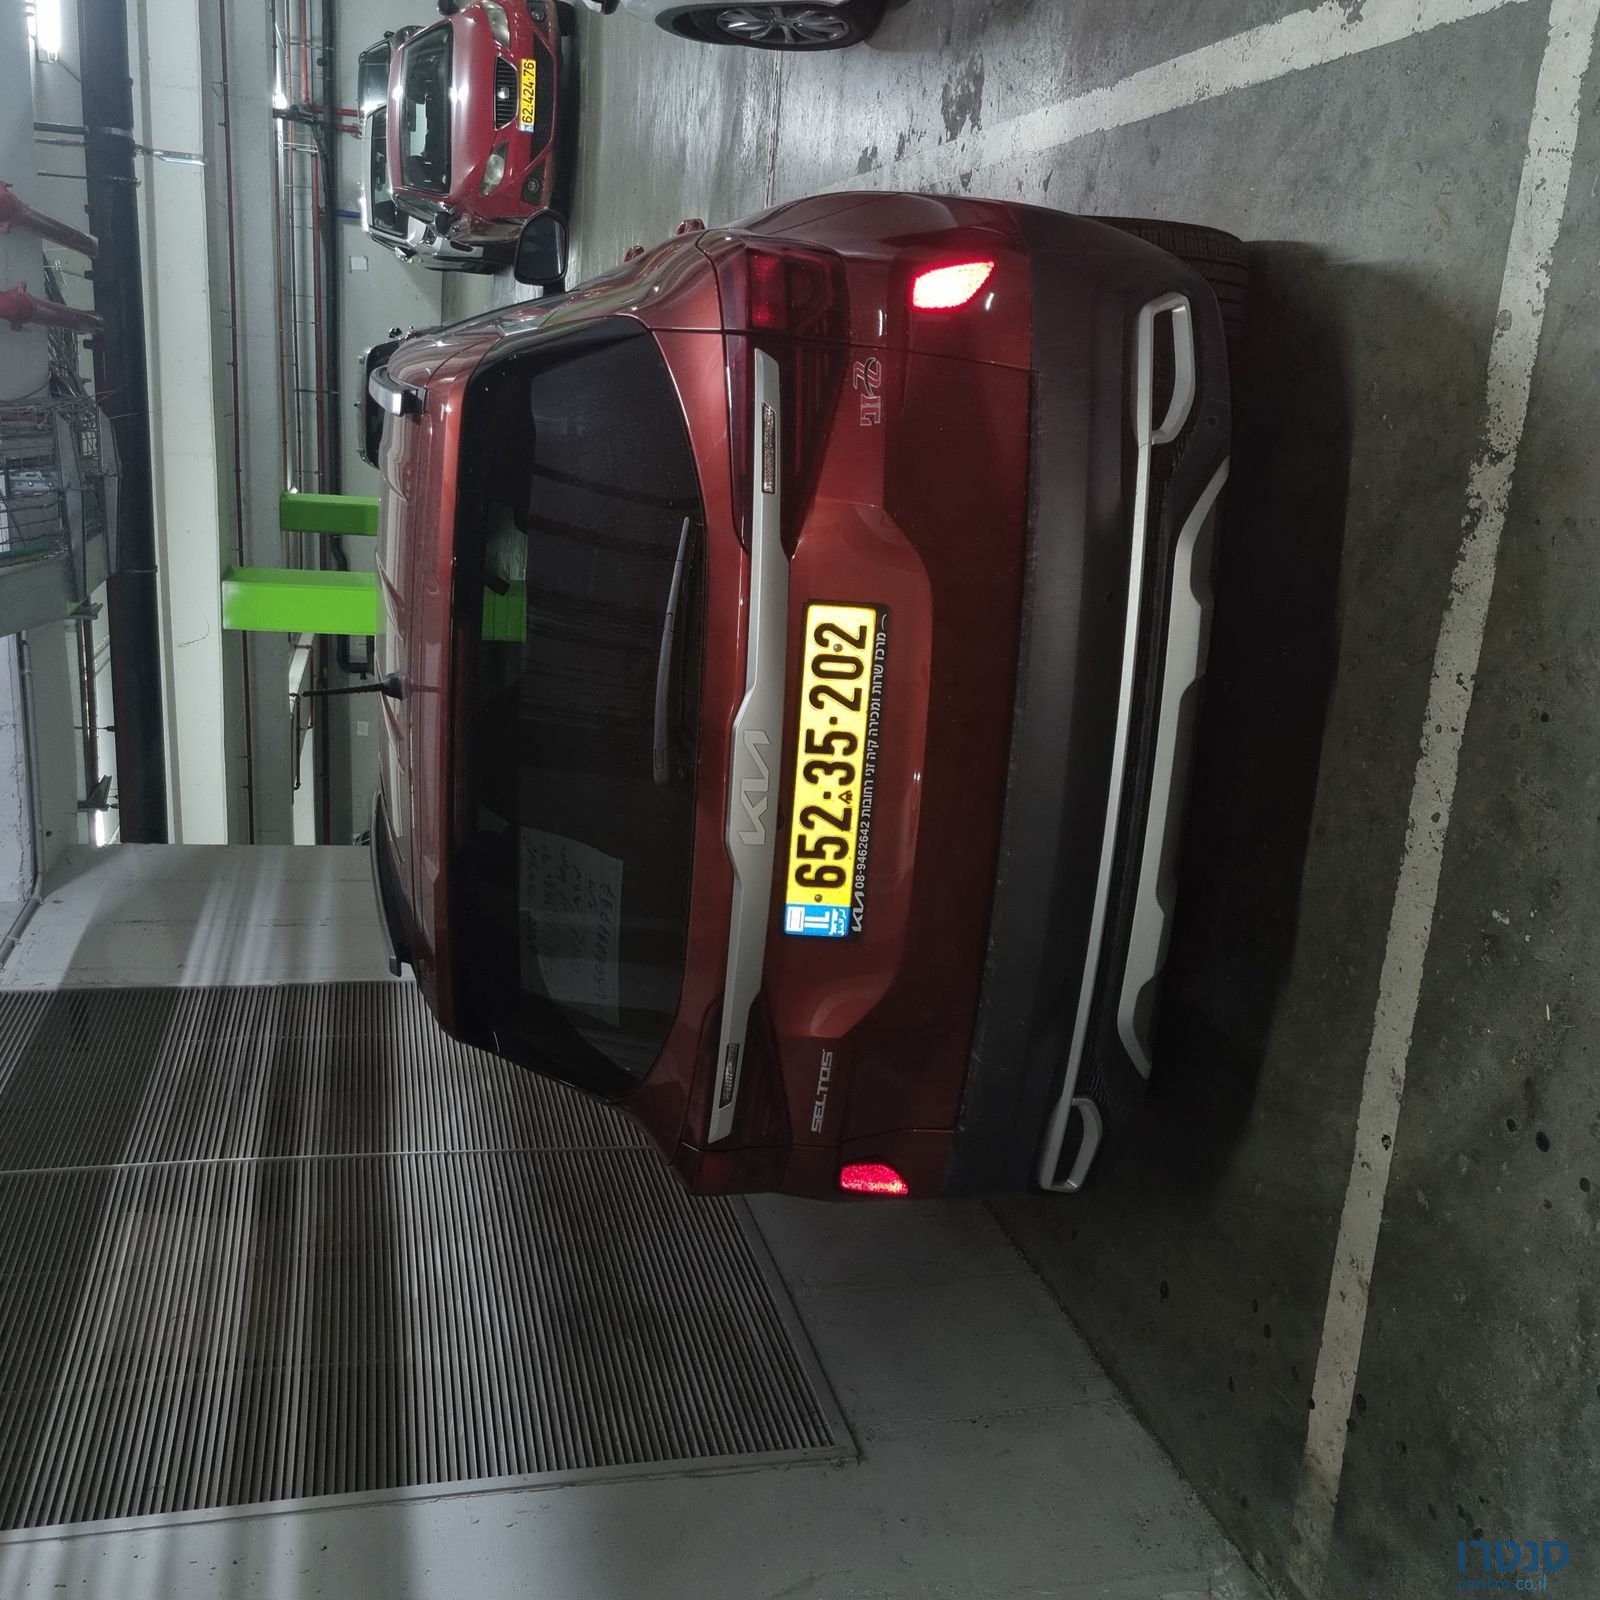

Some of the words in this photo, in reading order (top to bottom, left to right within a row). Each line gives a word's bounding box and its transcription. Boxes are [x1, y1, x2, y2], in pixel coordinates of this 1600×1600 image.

[875, 632, 886, 660] מרכז
[872, 663, 884, 694] שרות
[868, 698, 881, 736] ומכירה
[866, 739, 879, 760] קיה
[738, 730, 770, 845] KIA
[865, 762, 876, 777] זני
[861, 779, 875, 818] רחובות
[854, 821, 870, 889] 08-9462642
[804, 910, 830, 929] IL
[852, 891, 865, 932] KIA
[810, 1049, 833, 1134] SELTOS
